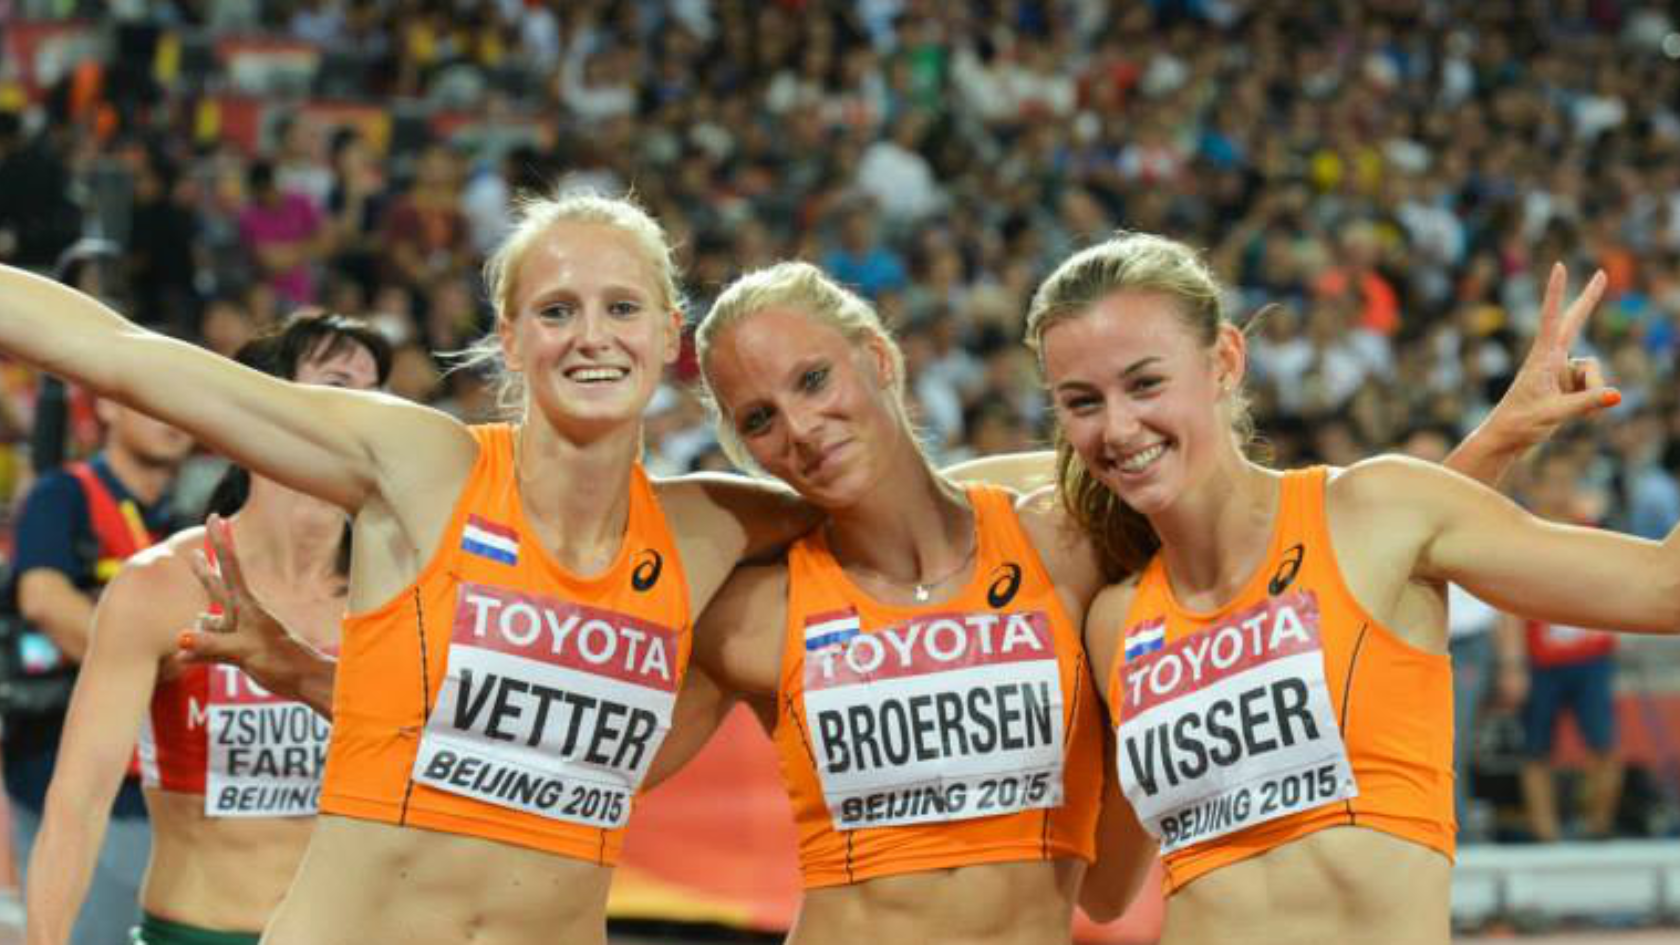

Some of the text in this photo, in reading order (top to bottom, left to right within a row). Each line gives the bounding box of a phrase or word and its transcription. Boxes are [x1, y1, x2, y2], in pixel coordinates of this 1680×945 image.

[464, 594, 671, 681] TOYOTA
[811, 613, 1043, 678] TOYOTA
[1127, 605, 1310, 707] TOYOTA
[452, 668, 659, 771] VETTER
[817, 680, 1053, 775] BROERSEN
[1125, 676, 1321, 797] VISSER
[423, 750, 624, 823] BEIJING 2015
[840, 782, 967, 823] BEIJING
[1159, 764, 1338, 847] BEIJING 2015
